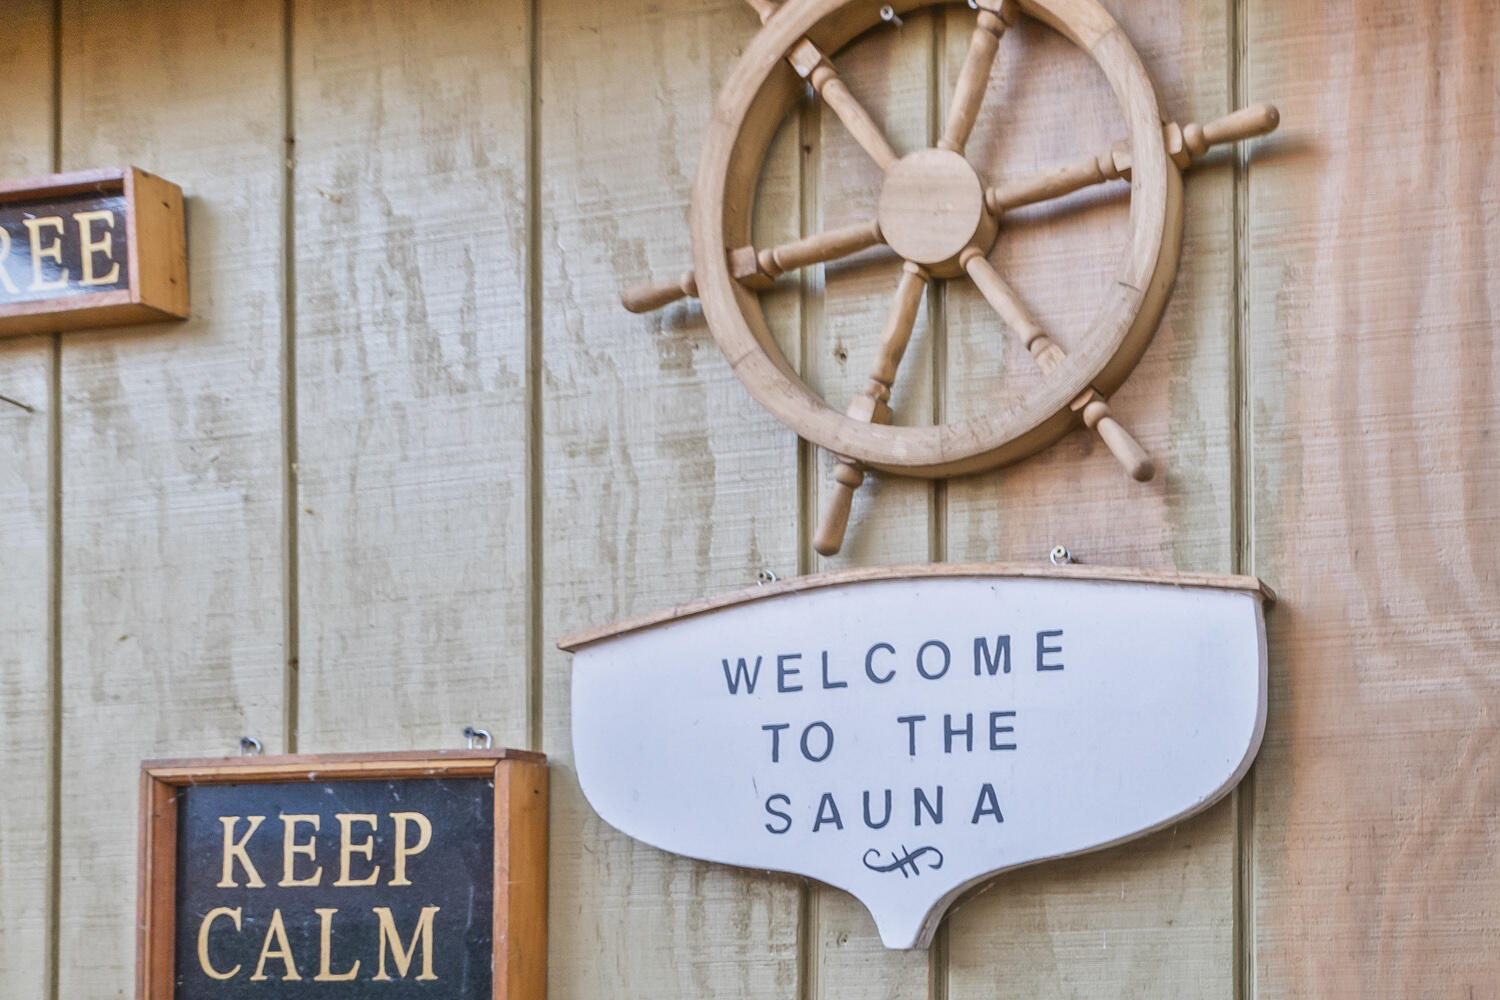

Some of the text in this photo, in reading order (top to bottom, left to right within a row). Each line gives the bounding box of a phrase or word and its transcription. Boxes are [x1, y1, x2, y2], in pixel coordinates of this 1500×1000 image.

[722, 630, 1064, 694] WELCOME
[762, 711, 1018, 763] TO THE
[765, 783, 1005, 835] SAUNA
[217, 812, 432, 888] KEEP
[197, 906, 440, 982] CALM
